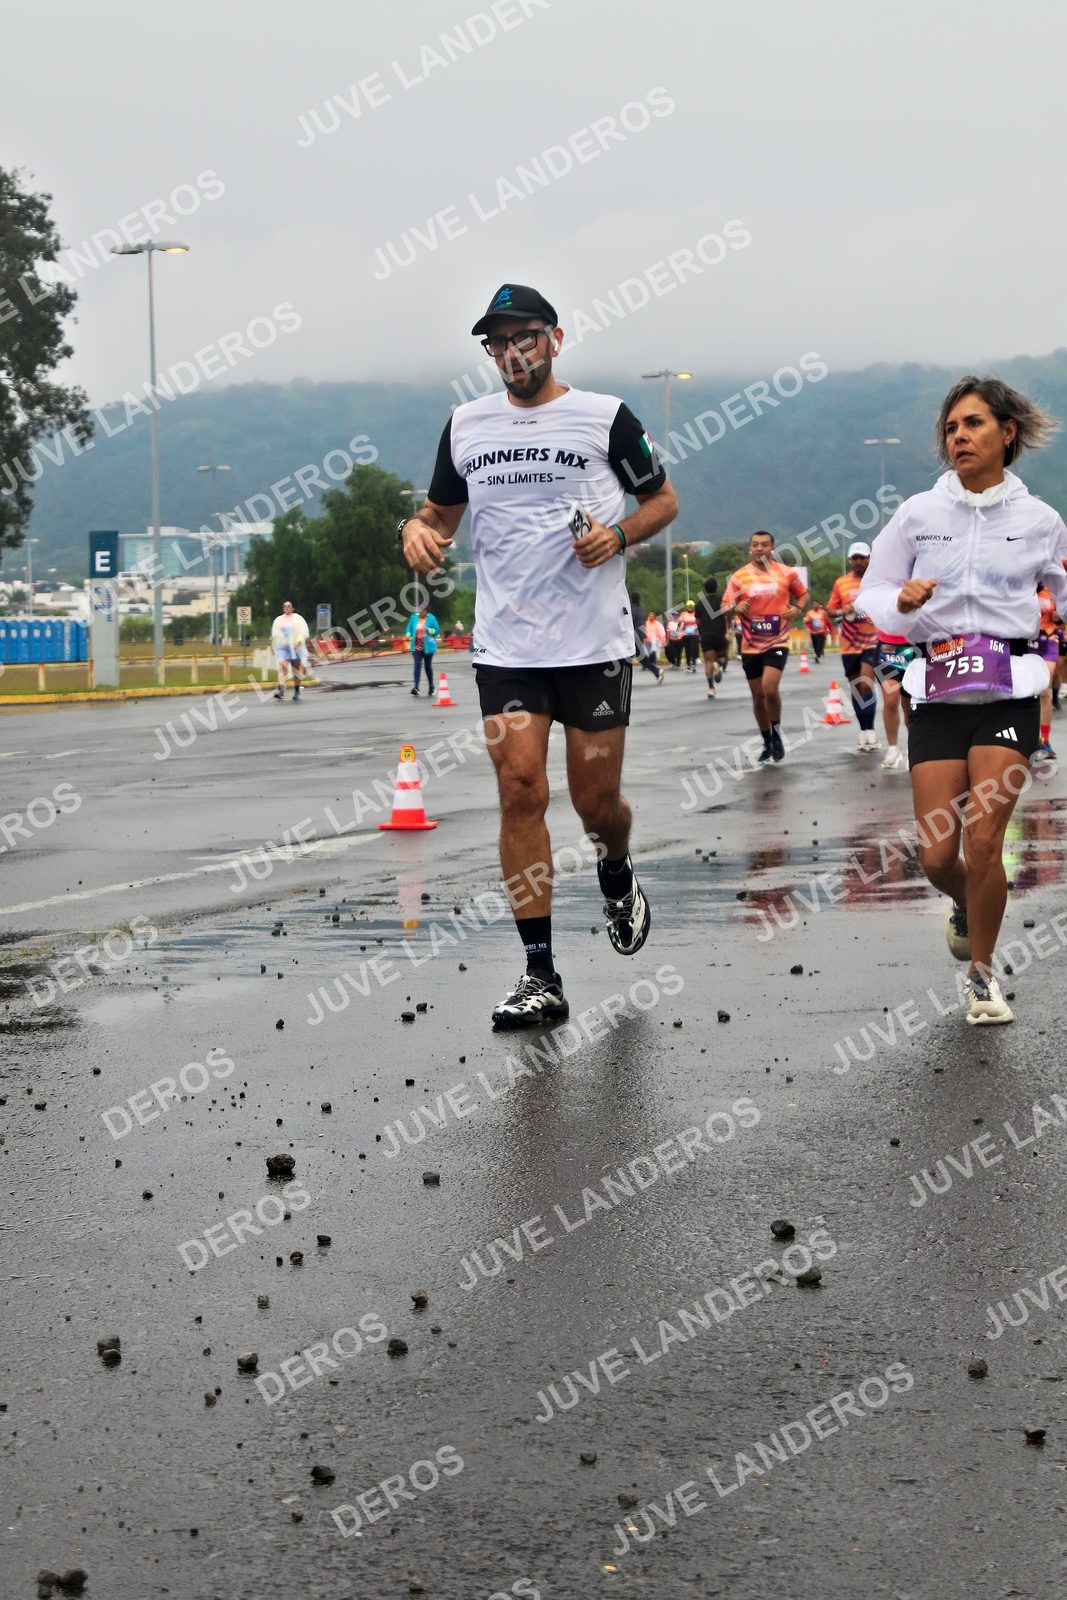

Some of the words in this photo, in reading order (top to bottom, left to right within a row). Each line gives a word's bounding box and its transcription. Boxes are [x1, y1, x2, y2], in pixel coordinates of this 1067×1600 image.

[466, 447, 551, 475] RUNNERS
[555, 450, 590, 470] MX
[487, 474, 504, 485] SIN
[508, 472, 553, 484] LÍMITES
[96, 551, 111, 571] E
[756, 622, 772, 630] 410
[989, 639, 1005, 654] 16K
[944, 655, 984, 678] 753
[592, 709, 615, 717] adidas
